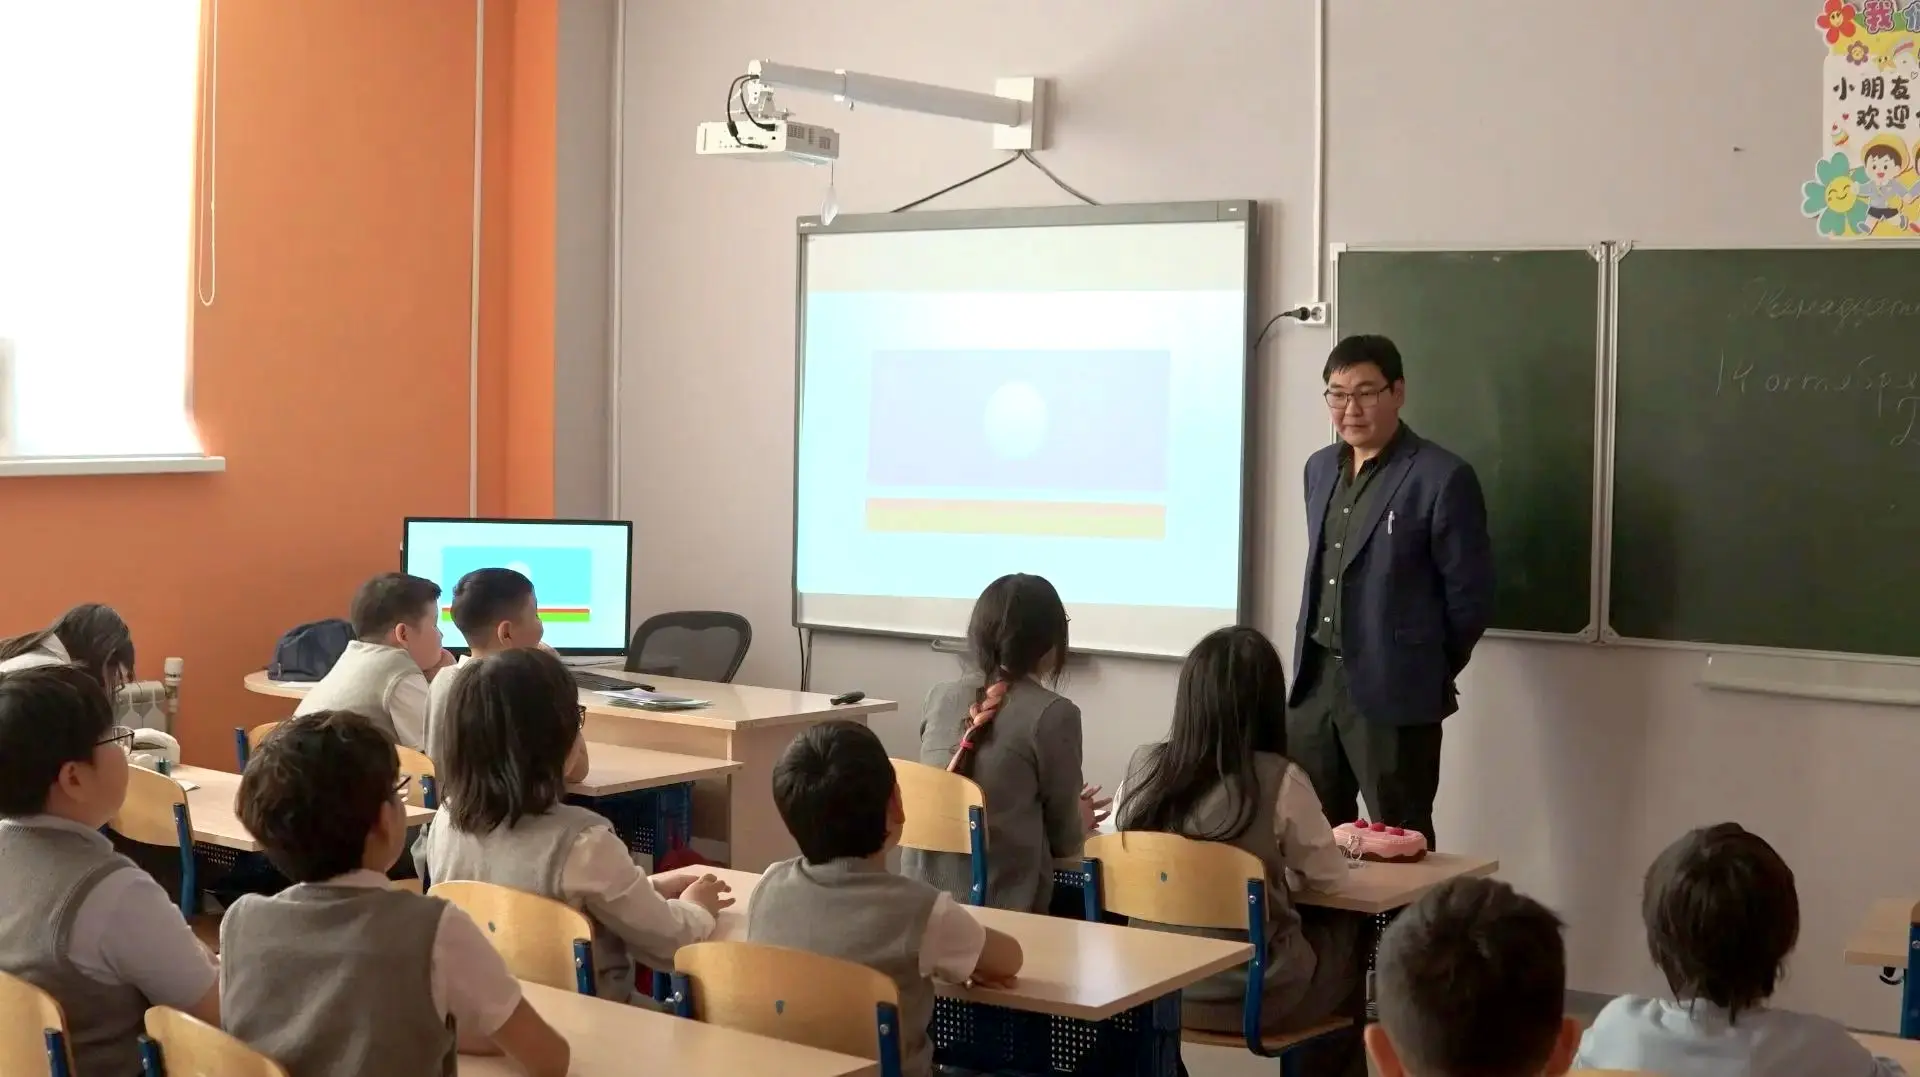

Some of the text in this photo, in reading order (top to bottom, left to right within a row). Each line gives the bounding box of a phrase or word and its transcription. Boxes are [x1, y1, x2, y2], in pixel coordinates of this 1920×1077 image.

[1833, 75, 1910, 100] 小朋友
[1856, 104, 1920, 130] 欢迎
